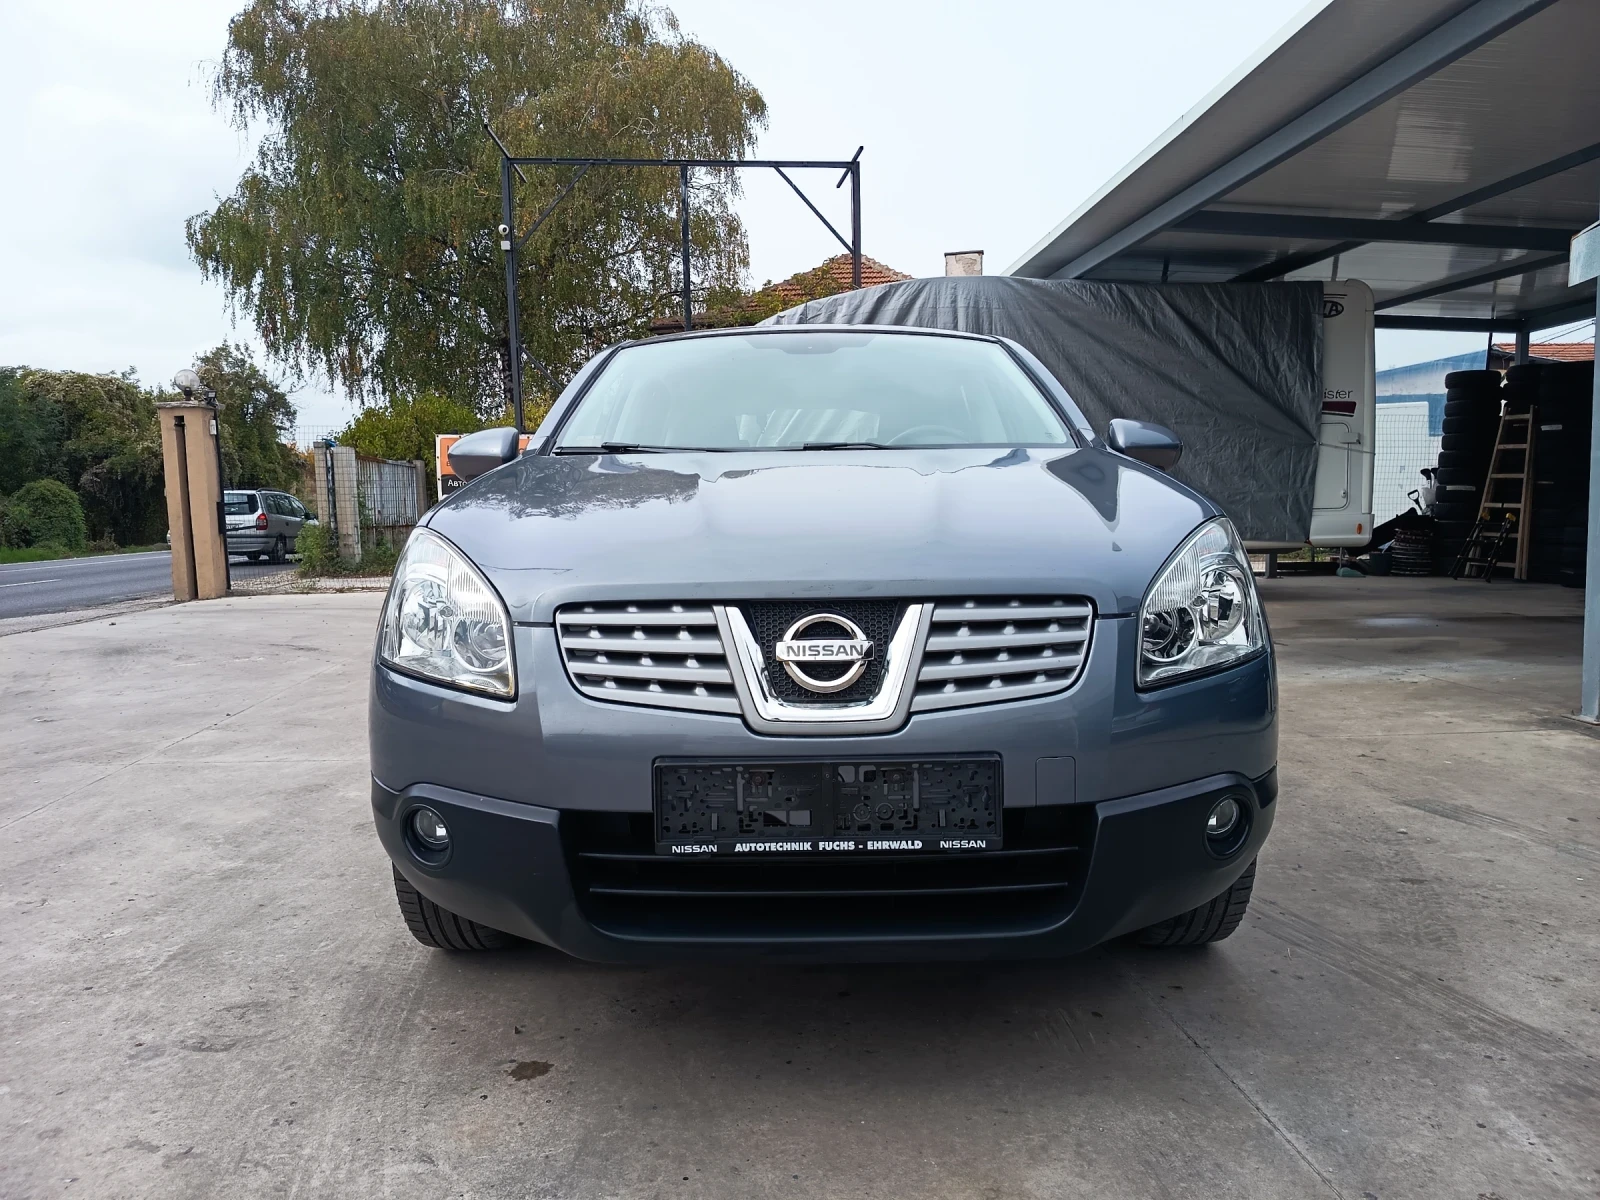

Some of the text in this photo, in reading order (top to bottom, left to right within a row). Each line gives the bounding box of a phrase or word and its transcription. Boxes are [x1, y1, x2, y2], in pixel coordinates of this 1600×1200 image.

[786, 645, 864, 657] NISSAN
[671, 844, 718, 853] NISSAN
[734, 842, 812, 852] AUTOTECHNIK
[818, 841, 855, 850] FUCHS
[867, 840, 923, 850] EHRWALD
[939, 840, 986, 848] NISSAN
